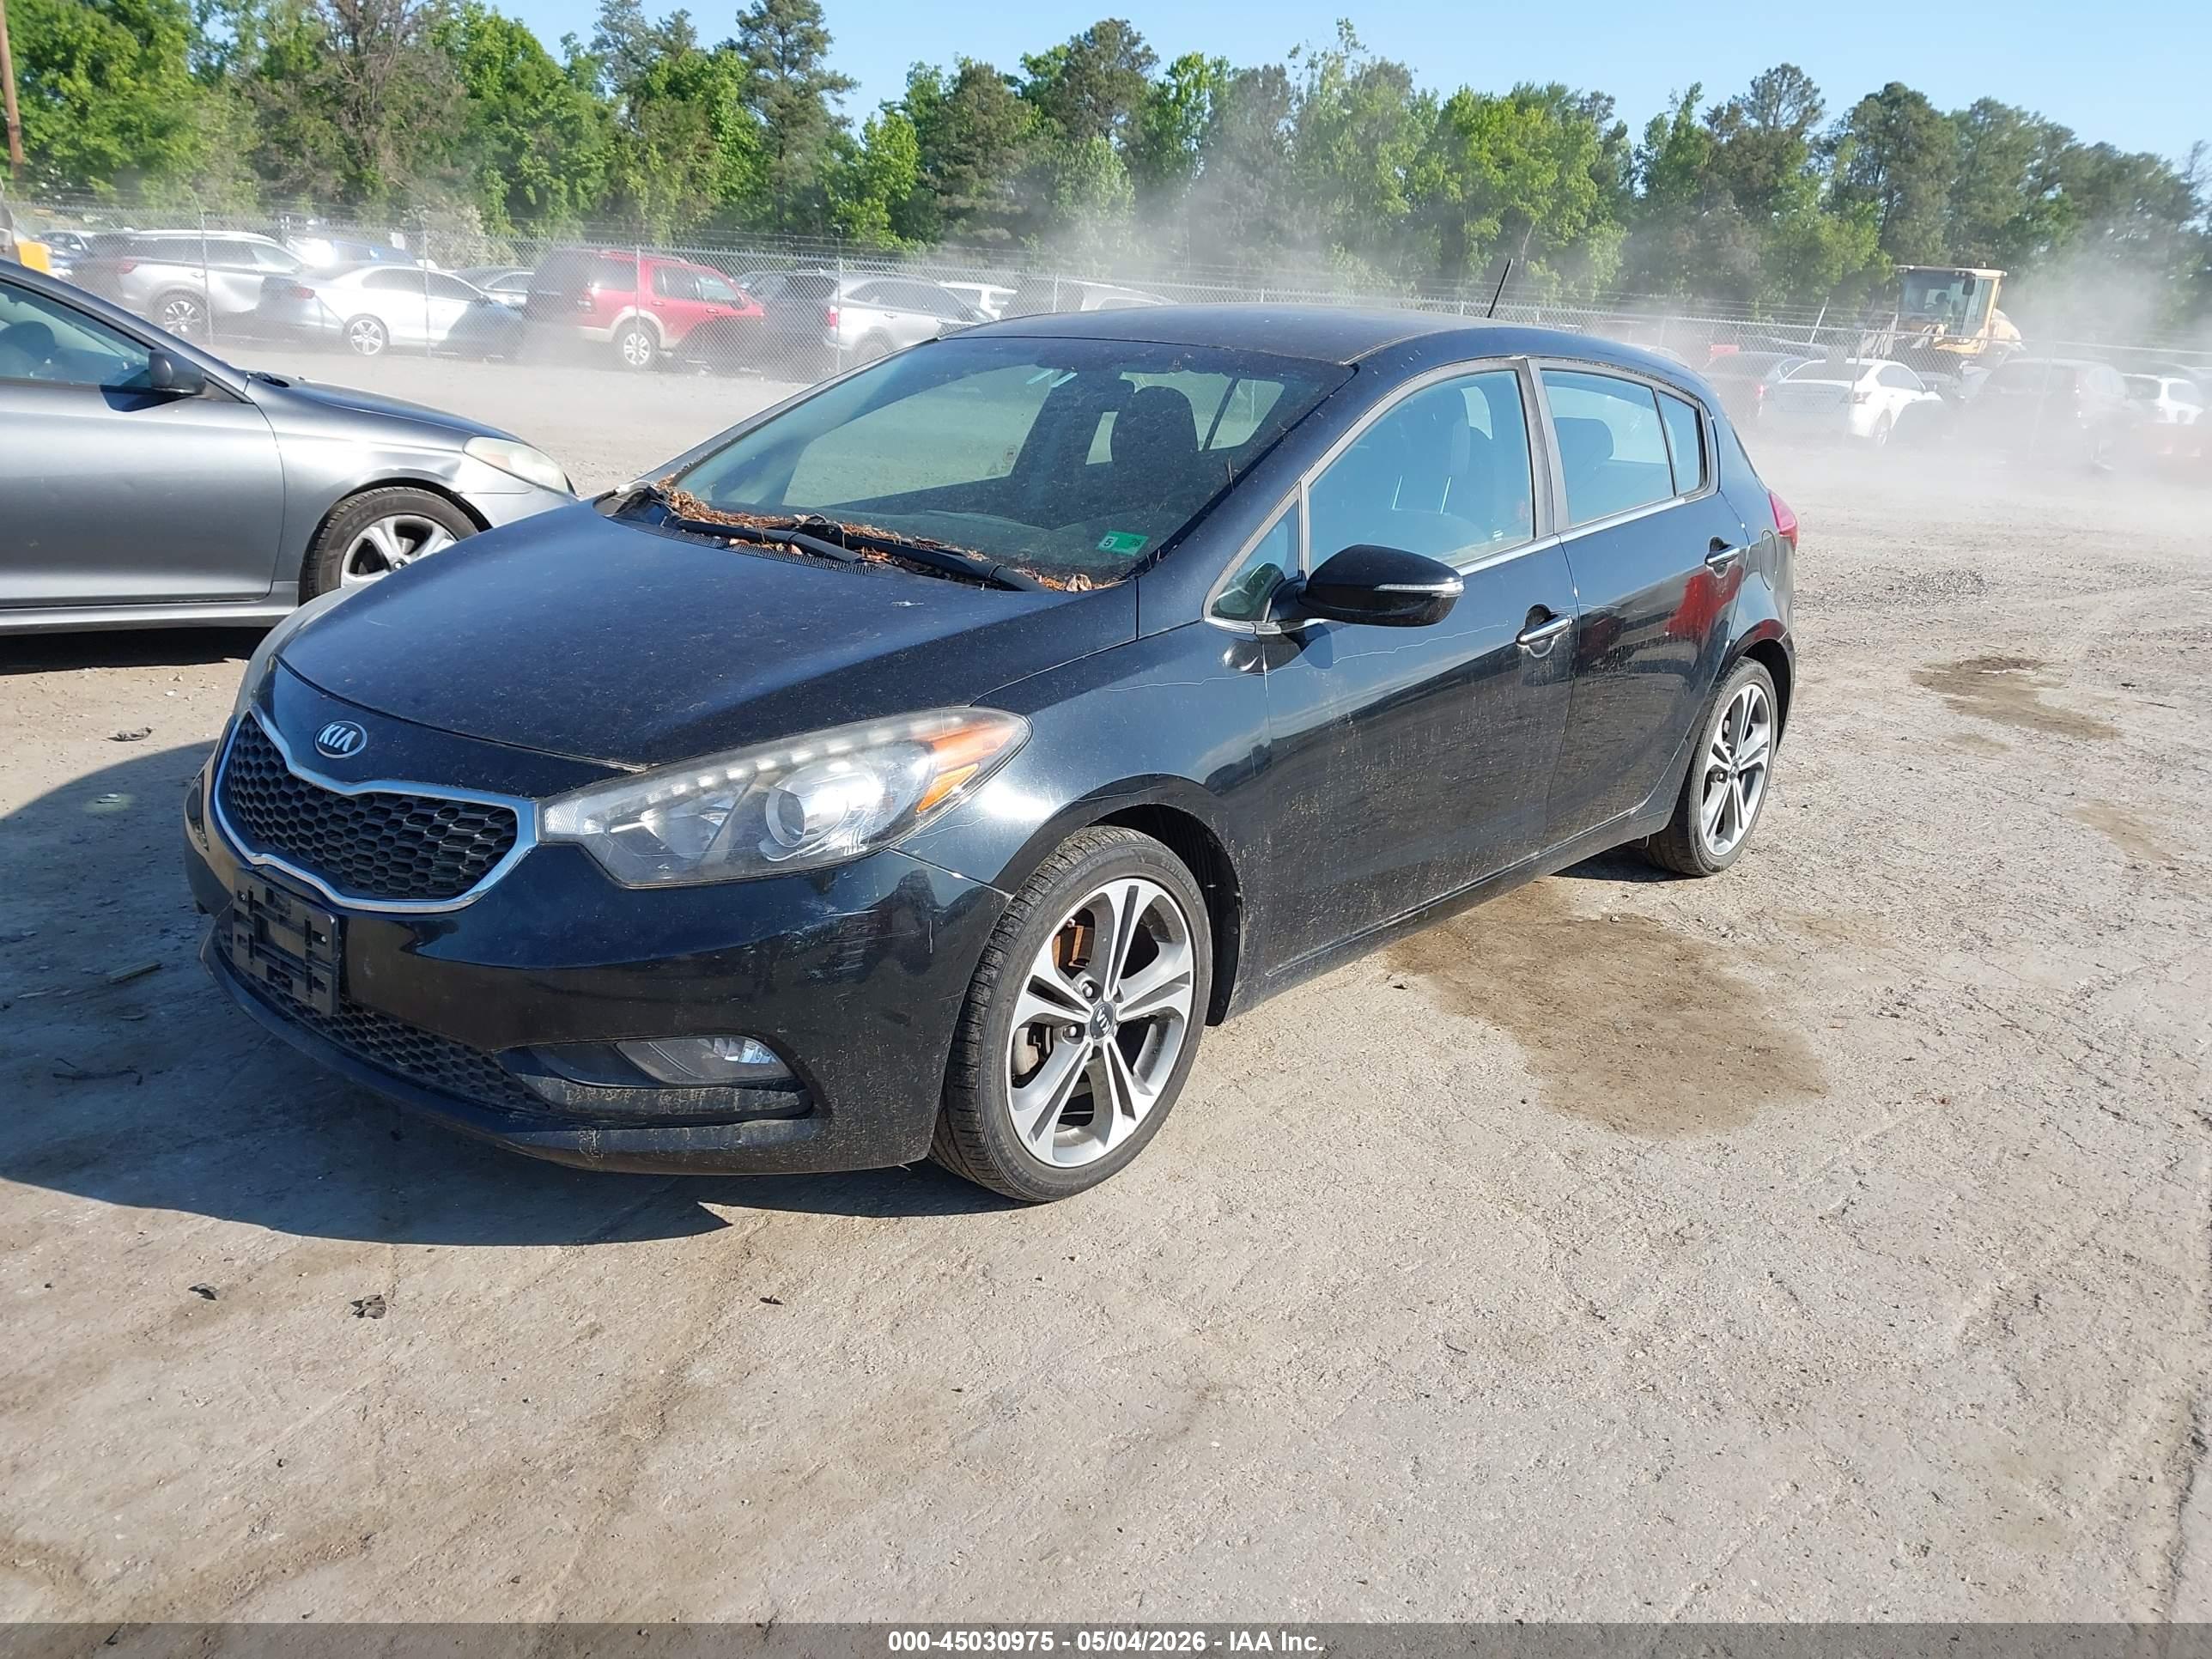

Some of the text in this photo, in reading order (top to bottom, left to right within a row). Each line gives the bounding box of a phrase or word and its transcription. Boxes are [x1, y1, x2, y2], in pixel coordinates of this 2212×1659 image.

[1103, 538, 1113, 546] 5
[319, 724, 357, 752] KIA
[1096, 1008, 1111, 1035] KIA
